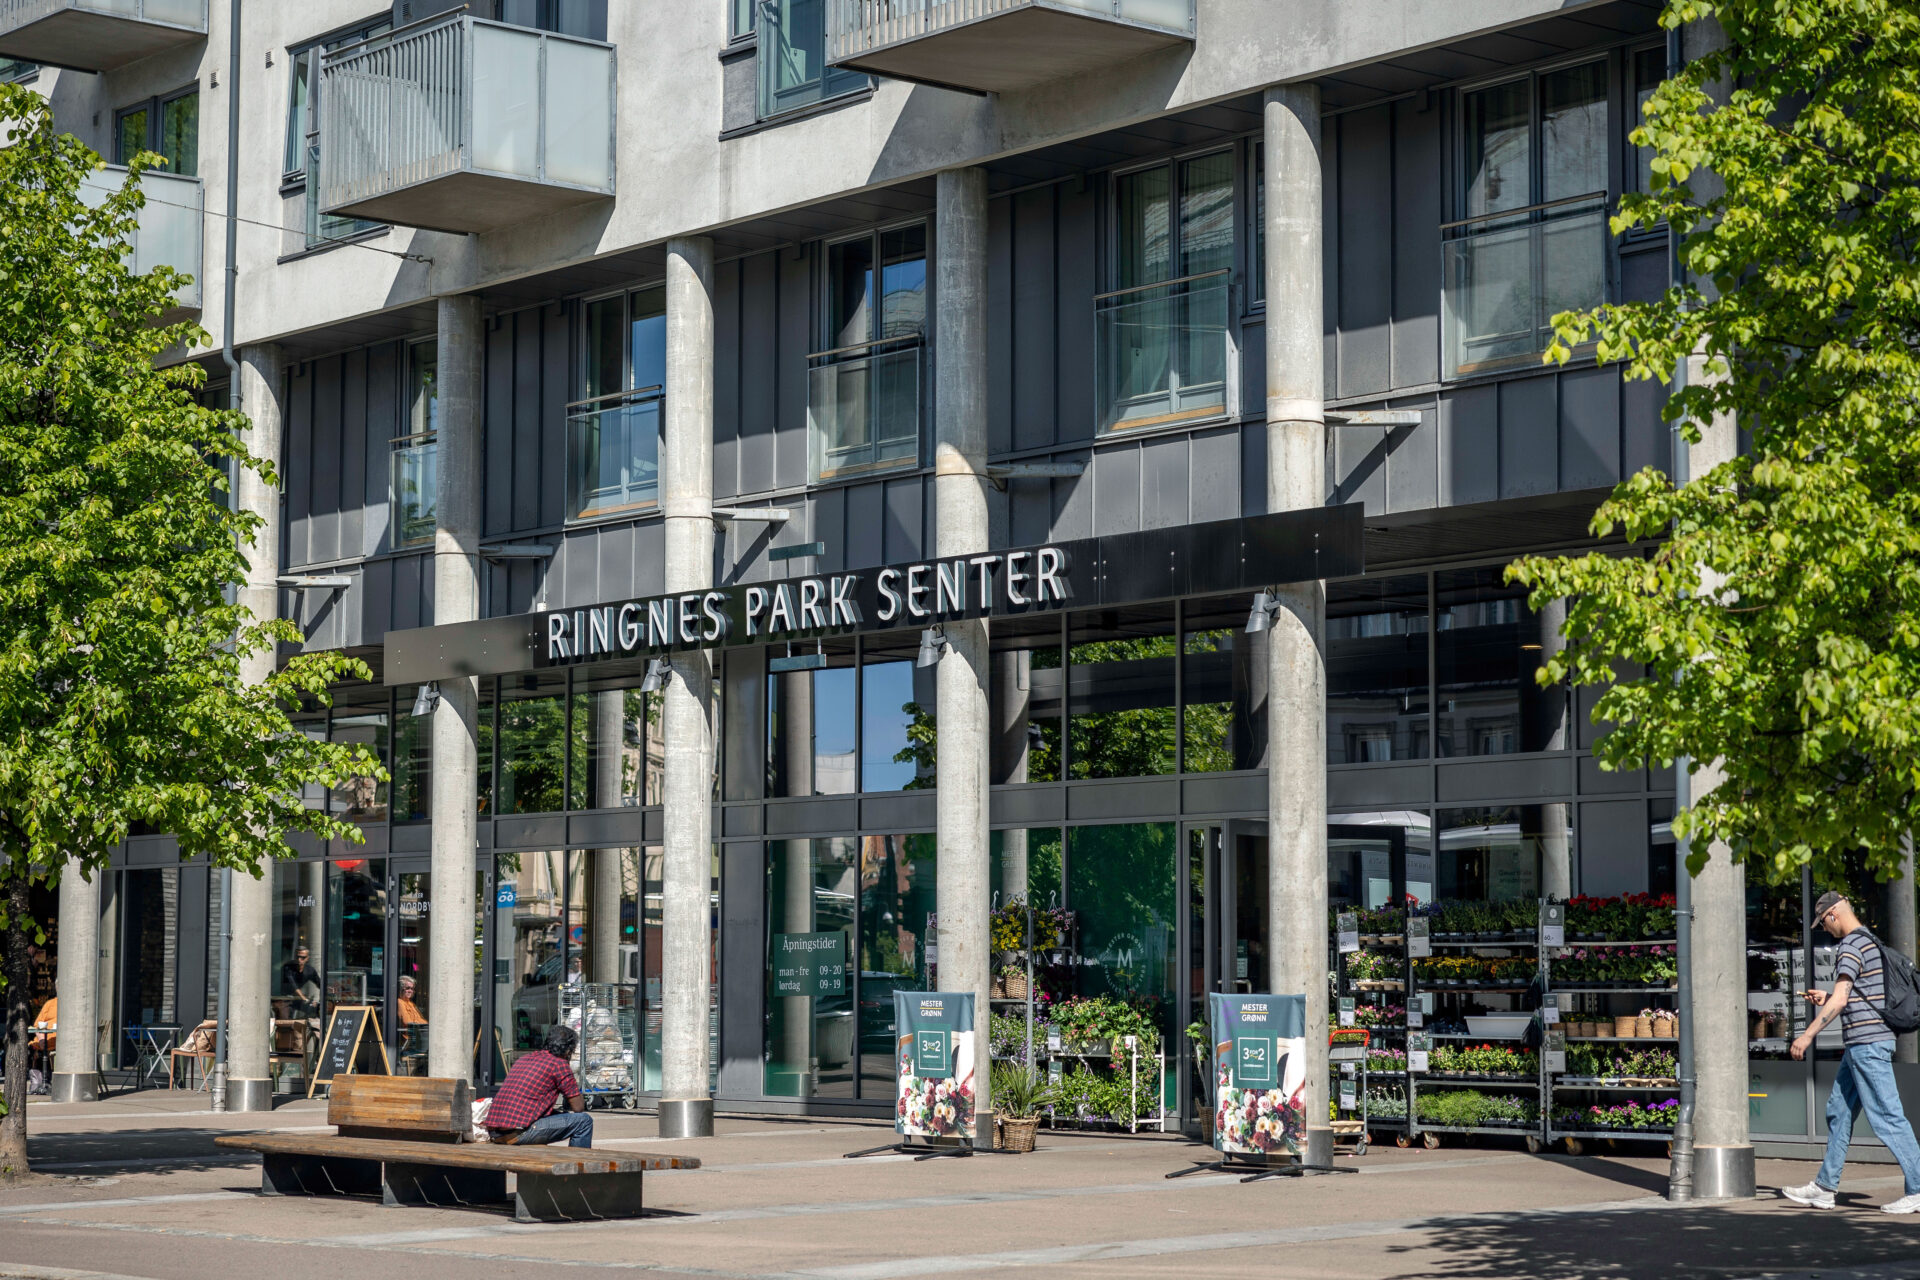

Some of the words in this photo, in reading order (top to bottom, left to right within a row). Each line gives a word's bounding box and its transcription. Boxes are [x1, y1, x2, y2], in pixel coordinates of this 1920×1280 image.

[548, 591, 727, 660] RINGNES
[746, 575, 857, 637] PARK
[877, 548, 1067, 622] SENTER
[298, 895, 316, 907] Kaffe
[400, 901, 432, 912] NORDBY
[782, 936, 837, 953] Åpningstider
[1117, 948, 1133, 969] M
[779, 968, 795, 976] man
[800, 966, 810, 976] fre
[779, 981, 801, 992] lørdag
[920, 1000, 943, 1008] MESTER
[1241, 1003, 1268, 1012] MESTER
[920, 1009, 942, 1017] GRØNN
[1241, 1014, 1267, 1022] GRØNN
[922, 1039, 928, 1052] 3
[935, 1040, 941, 1052] 2
[1242, 1047, 1250, 1060] 3
[1257, 1047, 1265, 1060] 2
